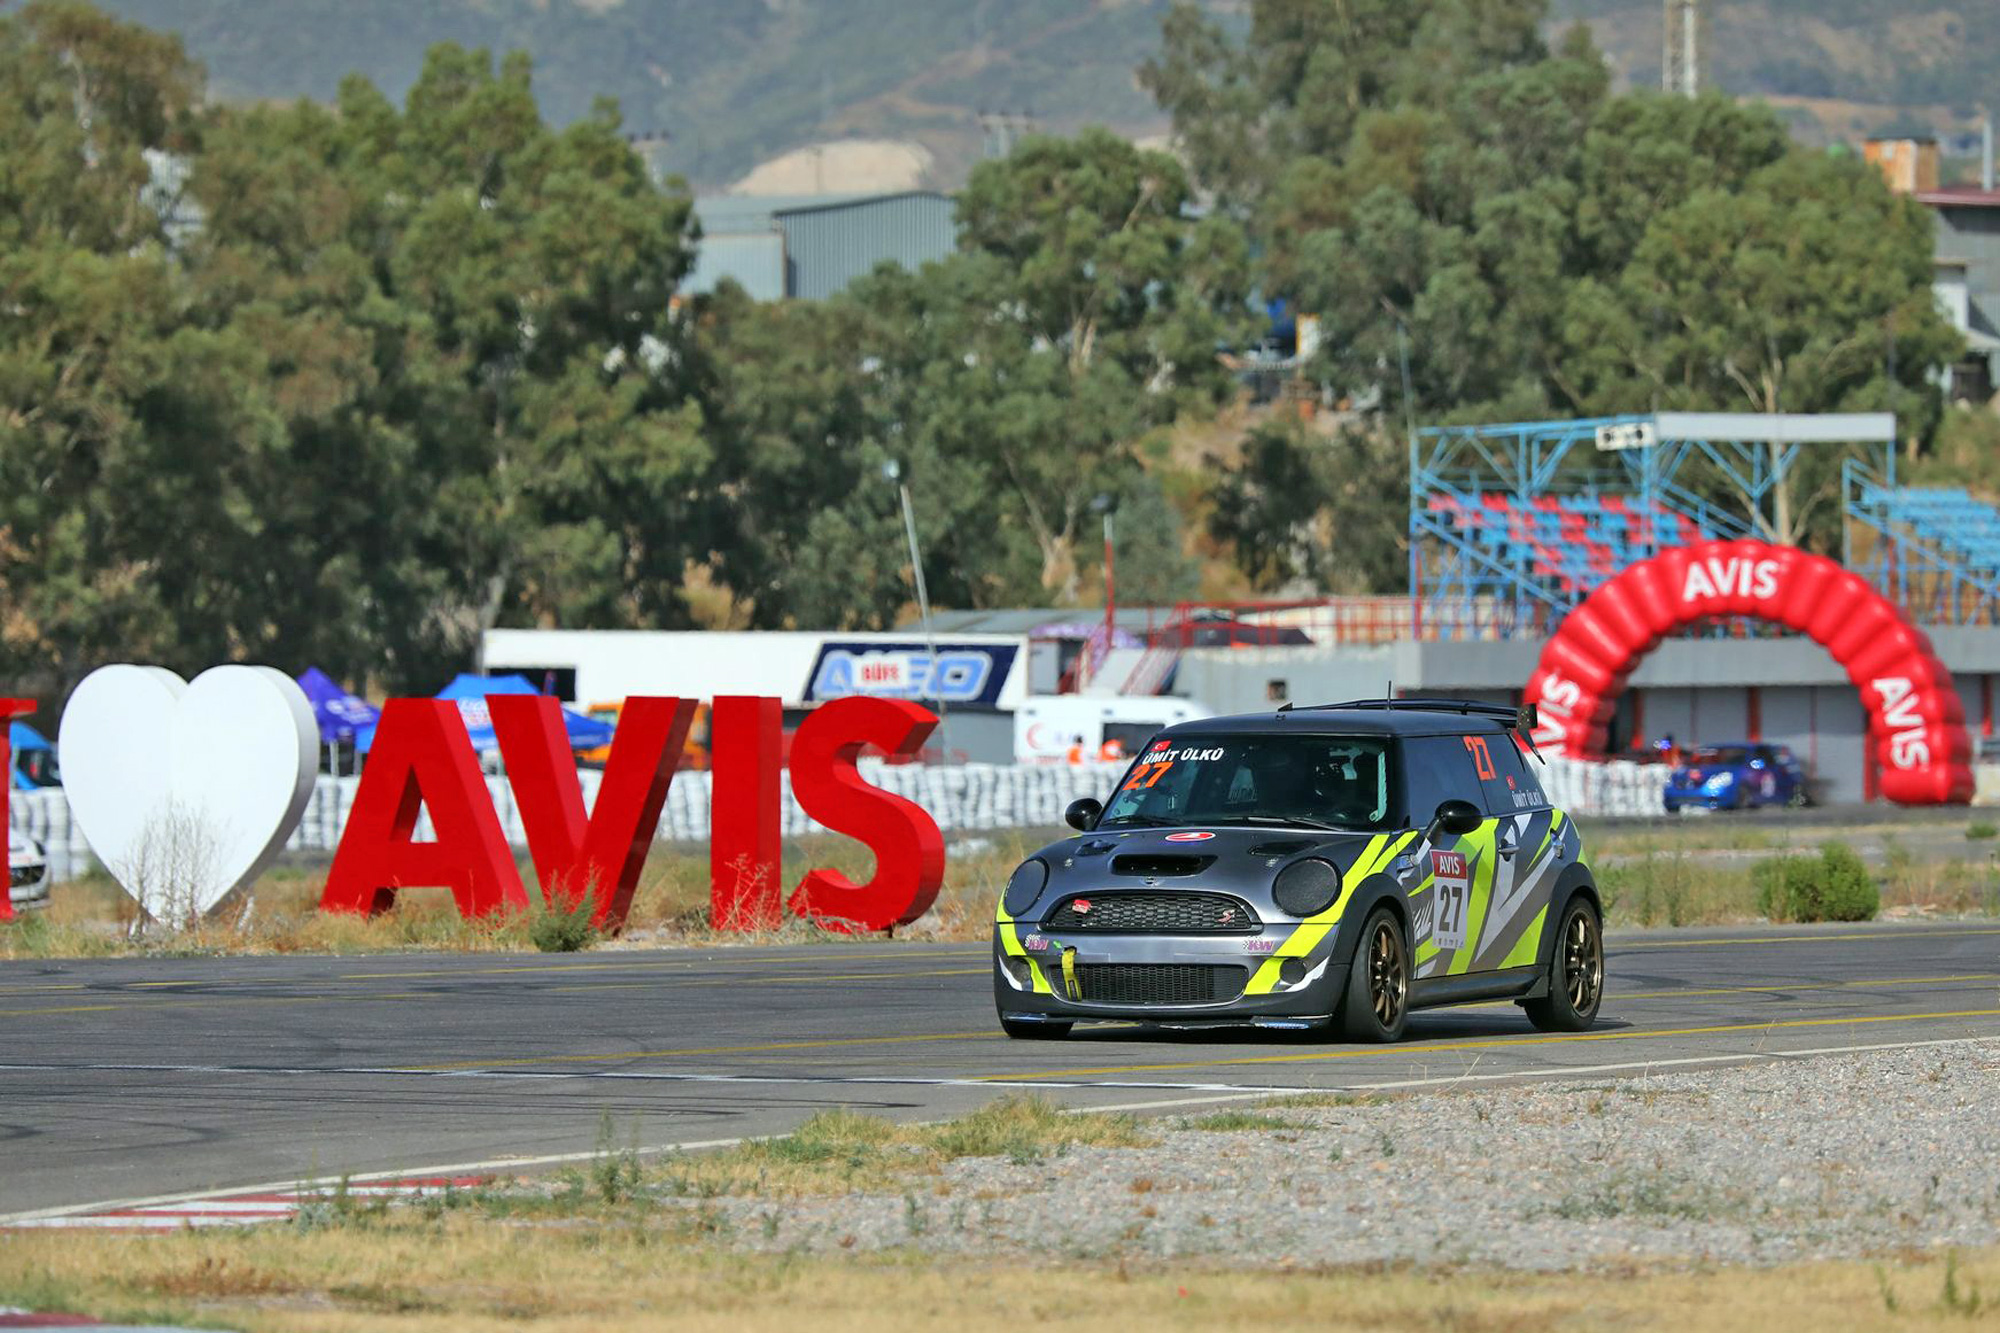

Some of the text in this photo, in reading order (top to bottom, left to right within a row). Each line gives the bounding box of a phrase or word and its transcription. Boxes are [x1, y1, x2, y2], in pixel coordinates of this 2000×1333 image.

[1682, 557, 1779, 602] AVIS
[1872, 677, 1929, 770] AVIS
[1122, 761, 1174, 790] 27
[1142, 748, 1224, 765] ÜMİT ÜLKÜ
[1462, 735, 1497, 780] 27
[318, 694, 945, 937] AVIS
[1439, 855, 1461, 875] AVIS
[1438, 884, 1463, 933] 27
